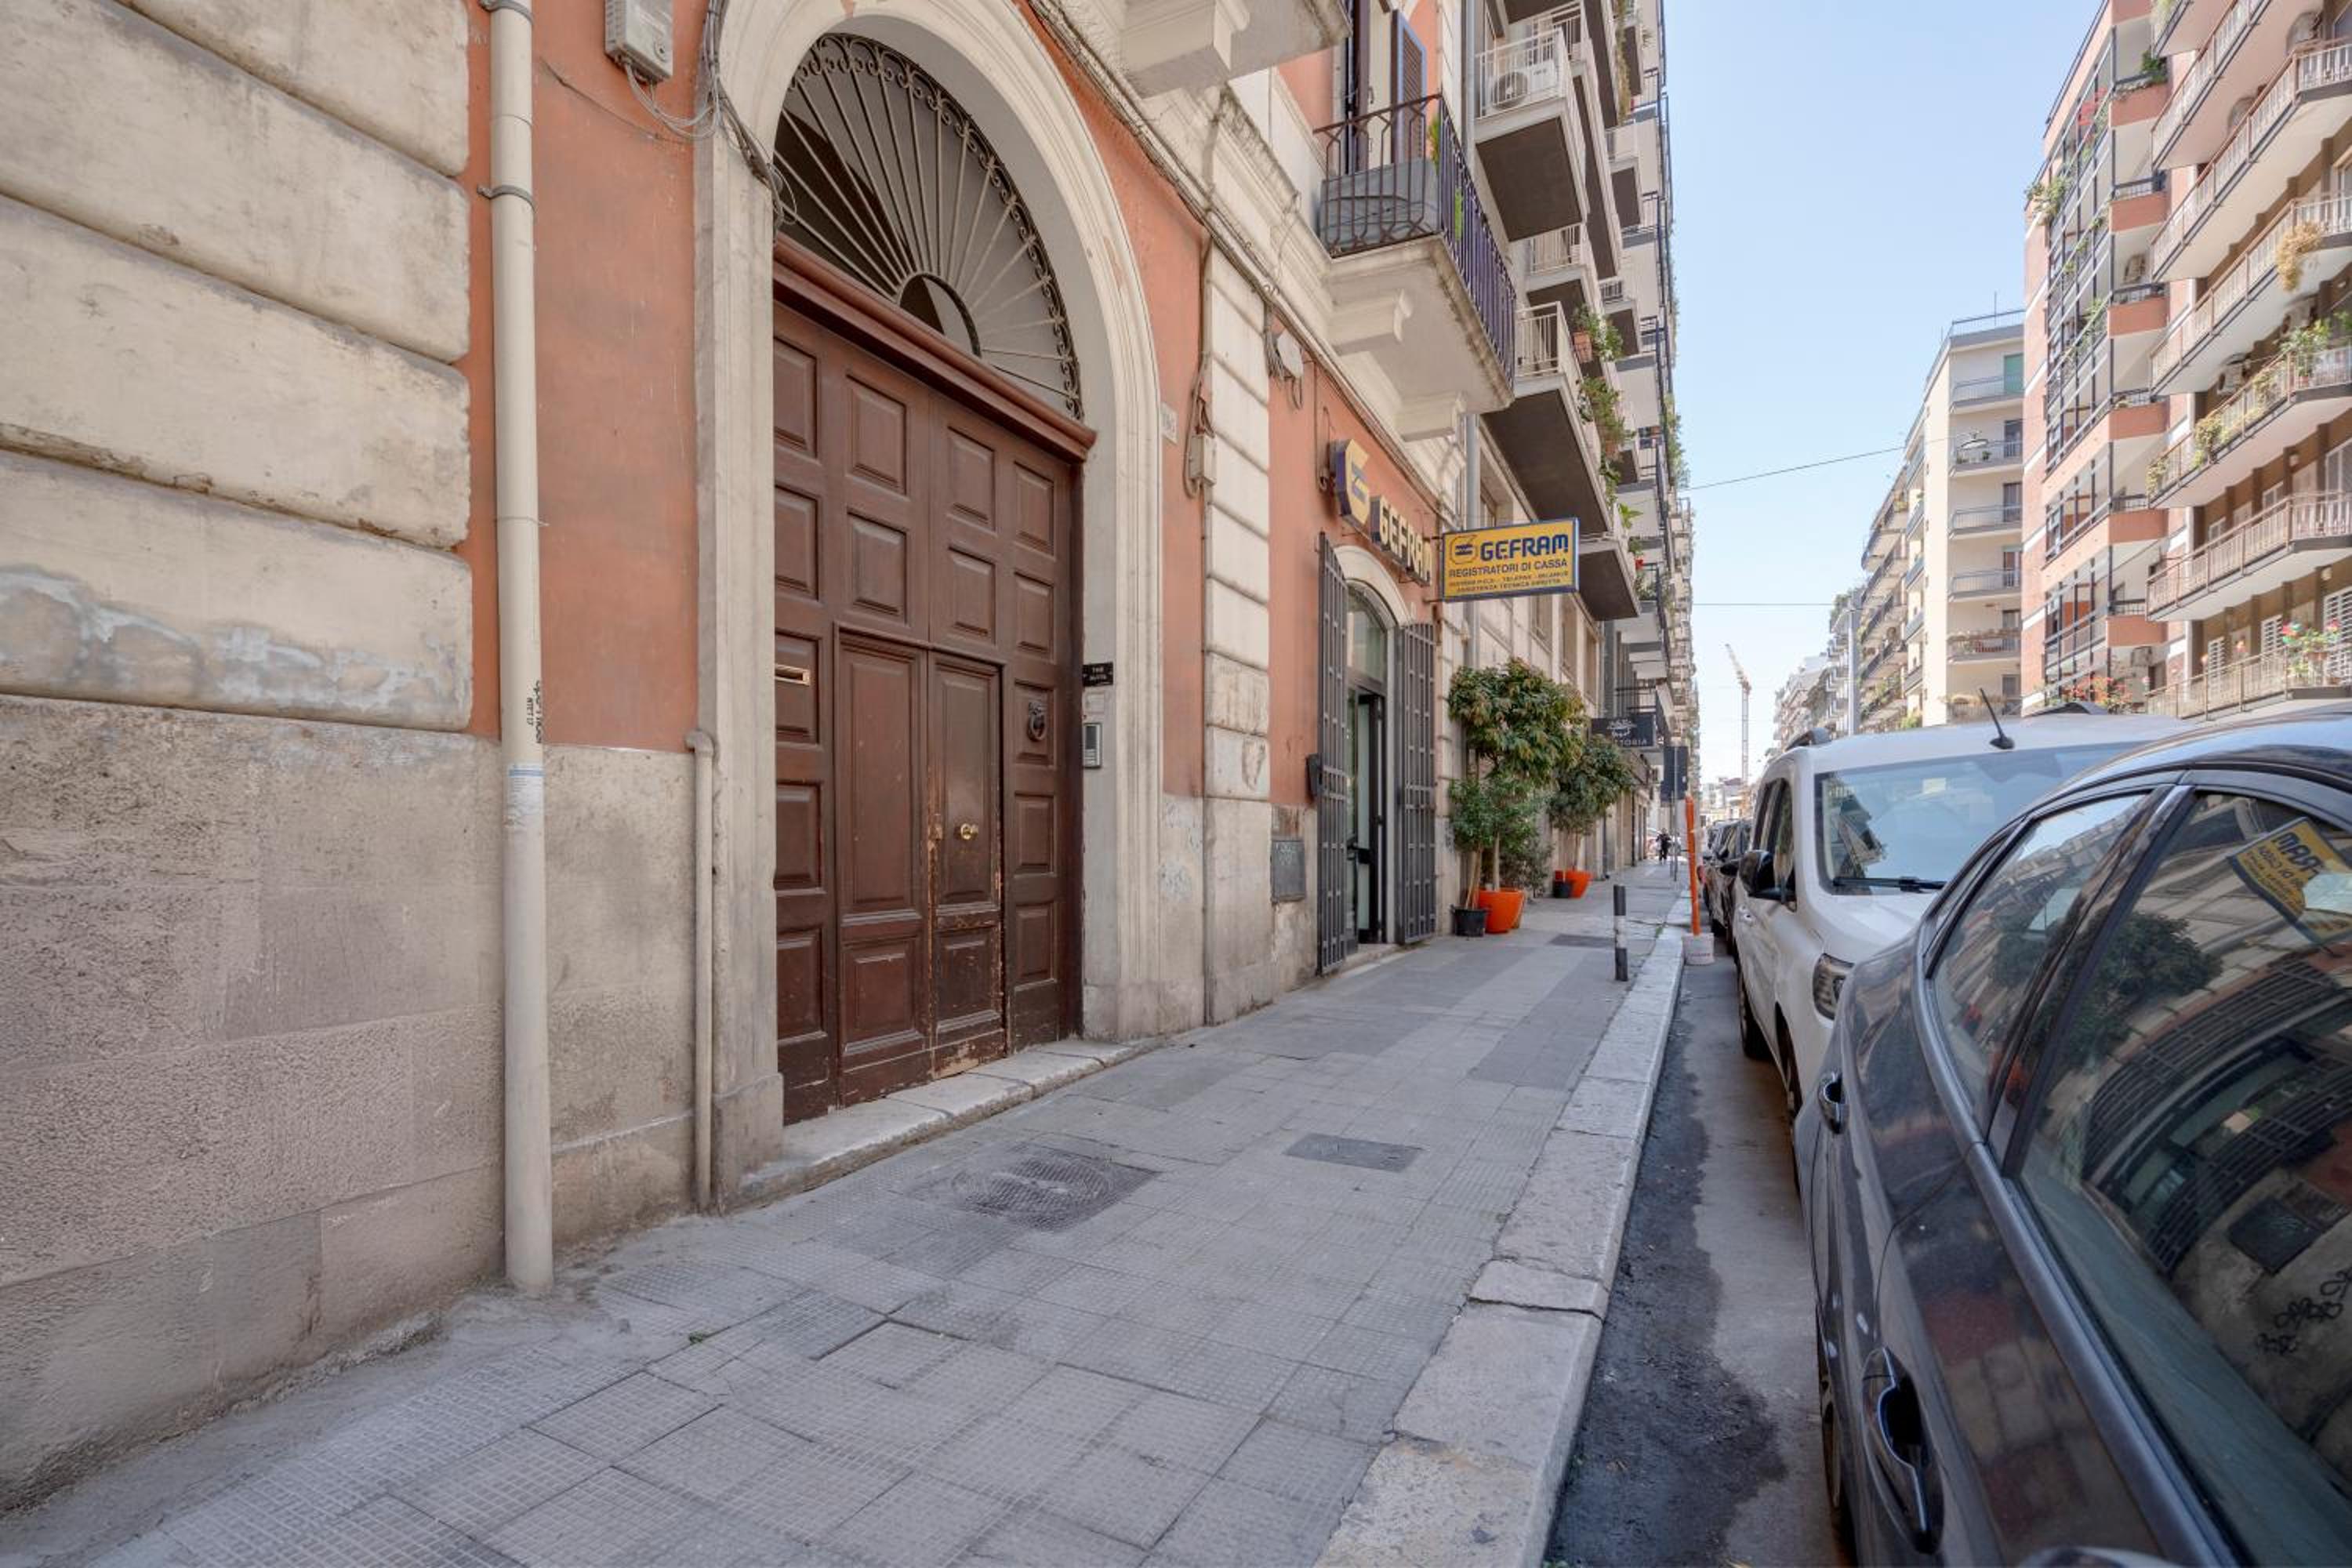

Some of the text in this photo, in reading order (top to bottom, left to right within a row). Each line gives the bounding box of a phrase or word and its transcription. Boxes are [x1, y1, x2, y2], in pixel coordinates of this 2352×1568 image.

[1480, 533, 1569, 561] GEFRAM
[1449, 557, 1568, 578] REGISTRATORI DI CASSA
